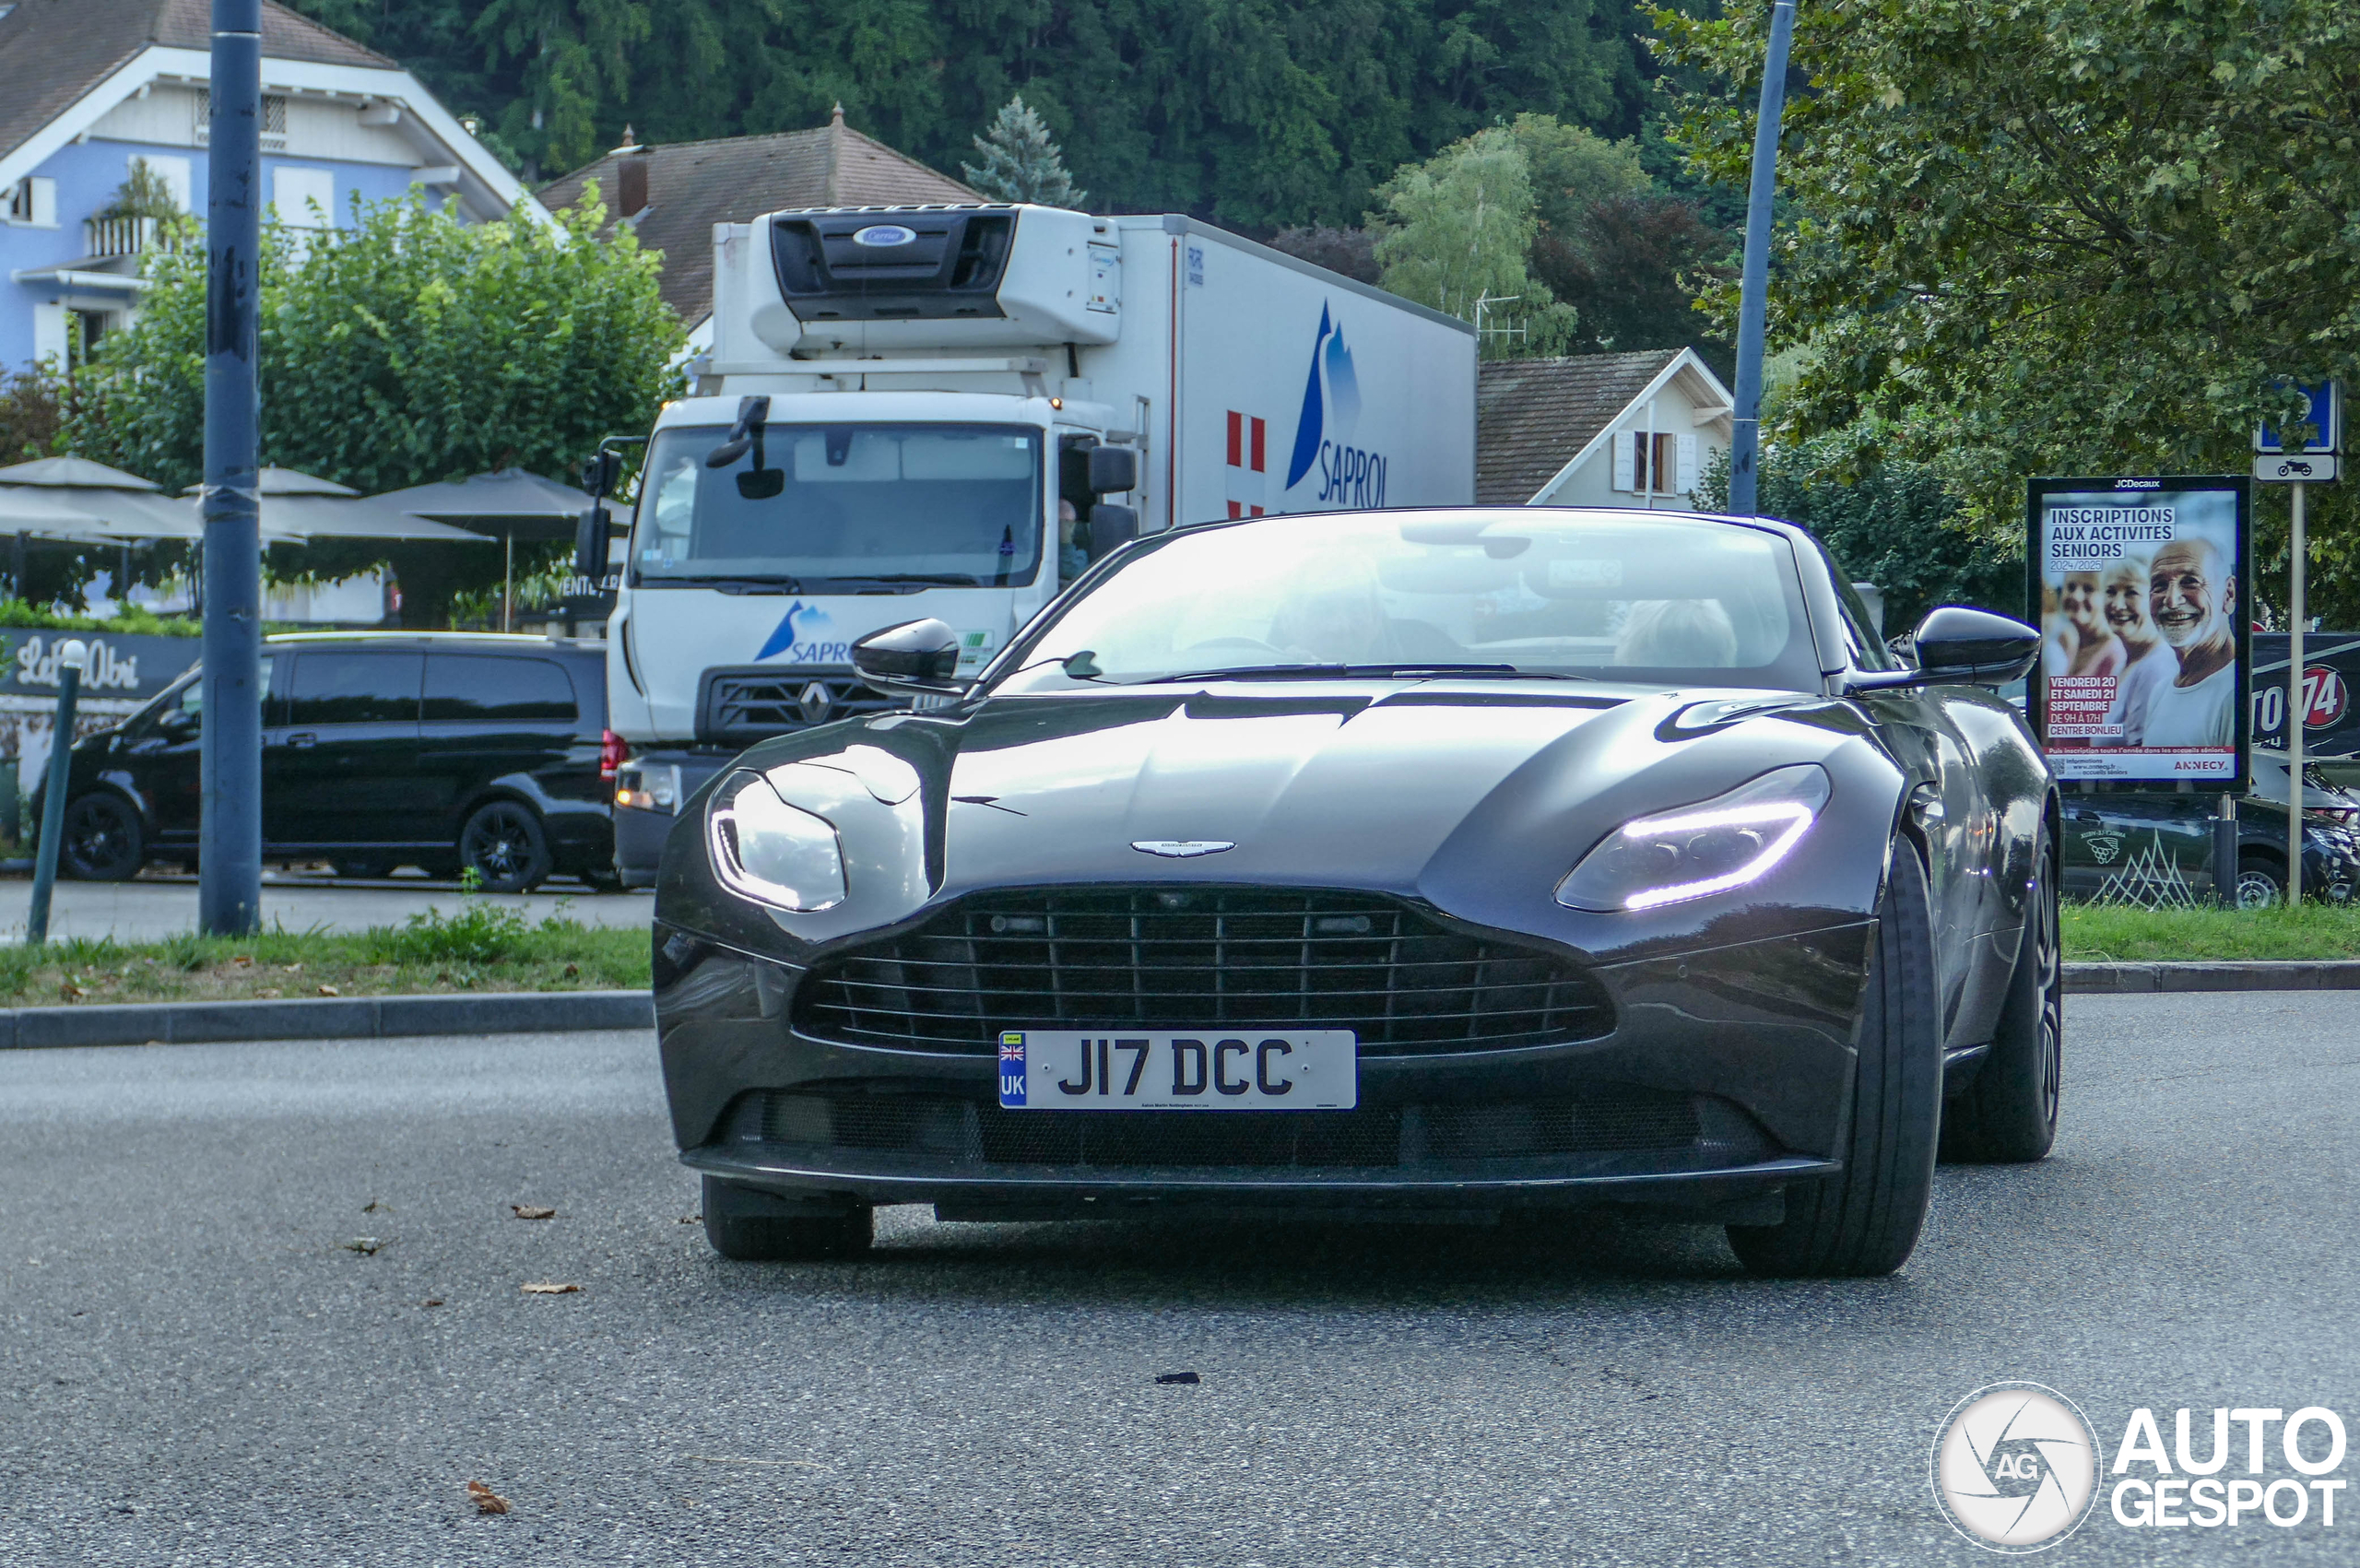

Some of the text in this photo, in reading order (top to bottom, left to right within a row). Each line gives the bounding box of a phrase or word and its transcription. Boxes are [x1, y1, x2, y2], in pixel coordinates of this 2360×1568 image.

[2115, 479, 2160, 489] JCDecaux
[2052, 509, 2173, 524] INSCRIPTIONS
[2052, 523, 2172, 540] AUX ACTIVITÉS
[2051, 540, 2122, 558] SÉNIORS
[2050, 560, 2102, 571] 2024/2025
[791, 642, 852, 664] SAPR
[2050, 677, 2116, 687] VENDREDI 20
[2051, 690, 2115, 699] ET SAMEDI 21
[2301, 671, 2338, 722] 74
[2050, 701, 2108, 711] SEPTEMBRE
[2051, 712, 2101, 724] DE 9H À 17H
[2050, 725, 2122, 735] CENTRE BONLIEU
[2174, 760, 2225, 771] ANNECY
[1058, 1039, 1292, 1096] J17 DCC
[1001, 1076, 1025, 1095] UK
